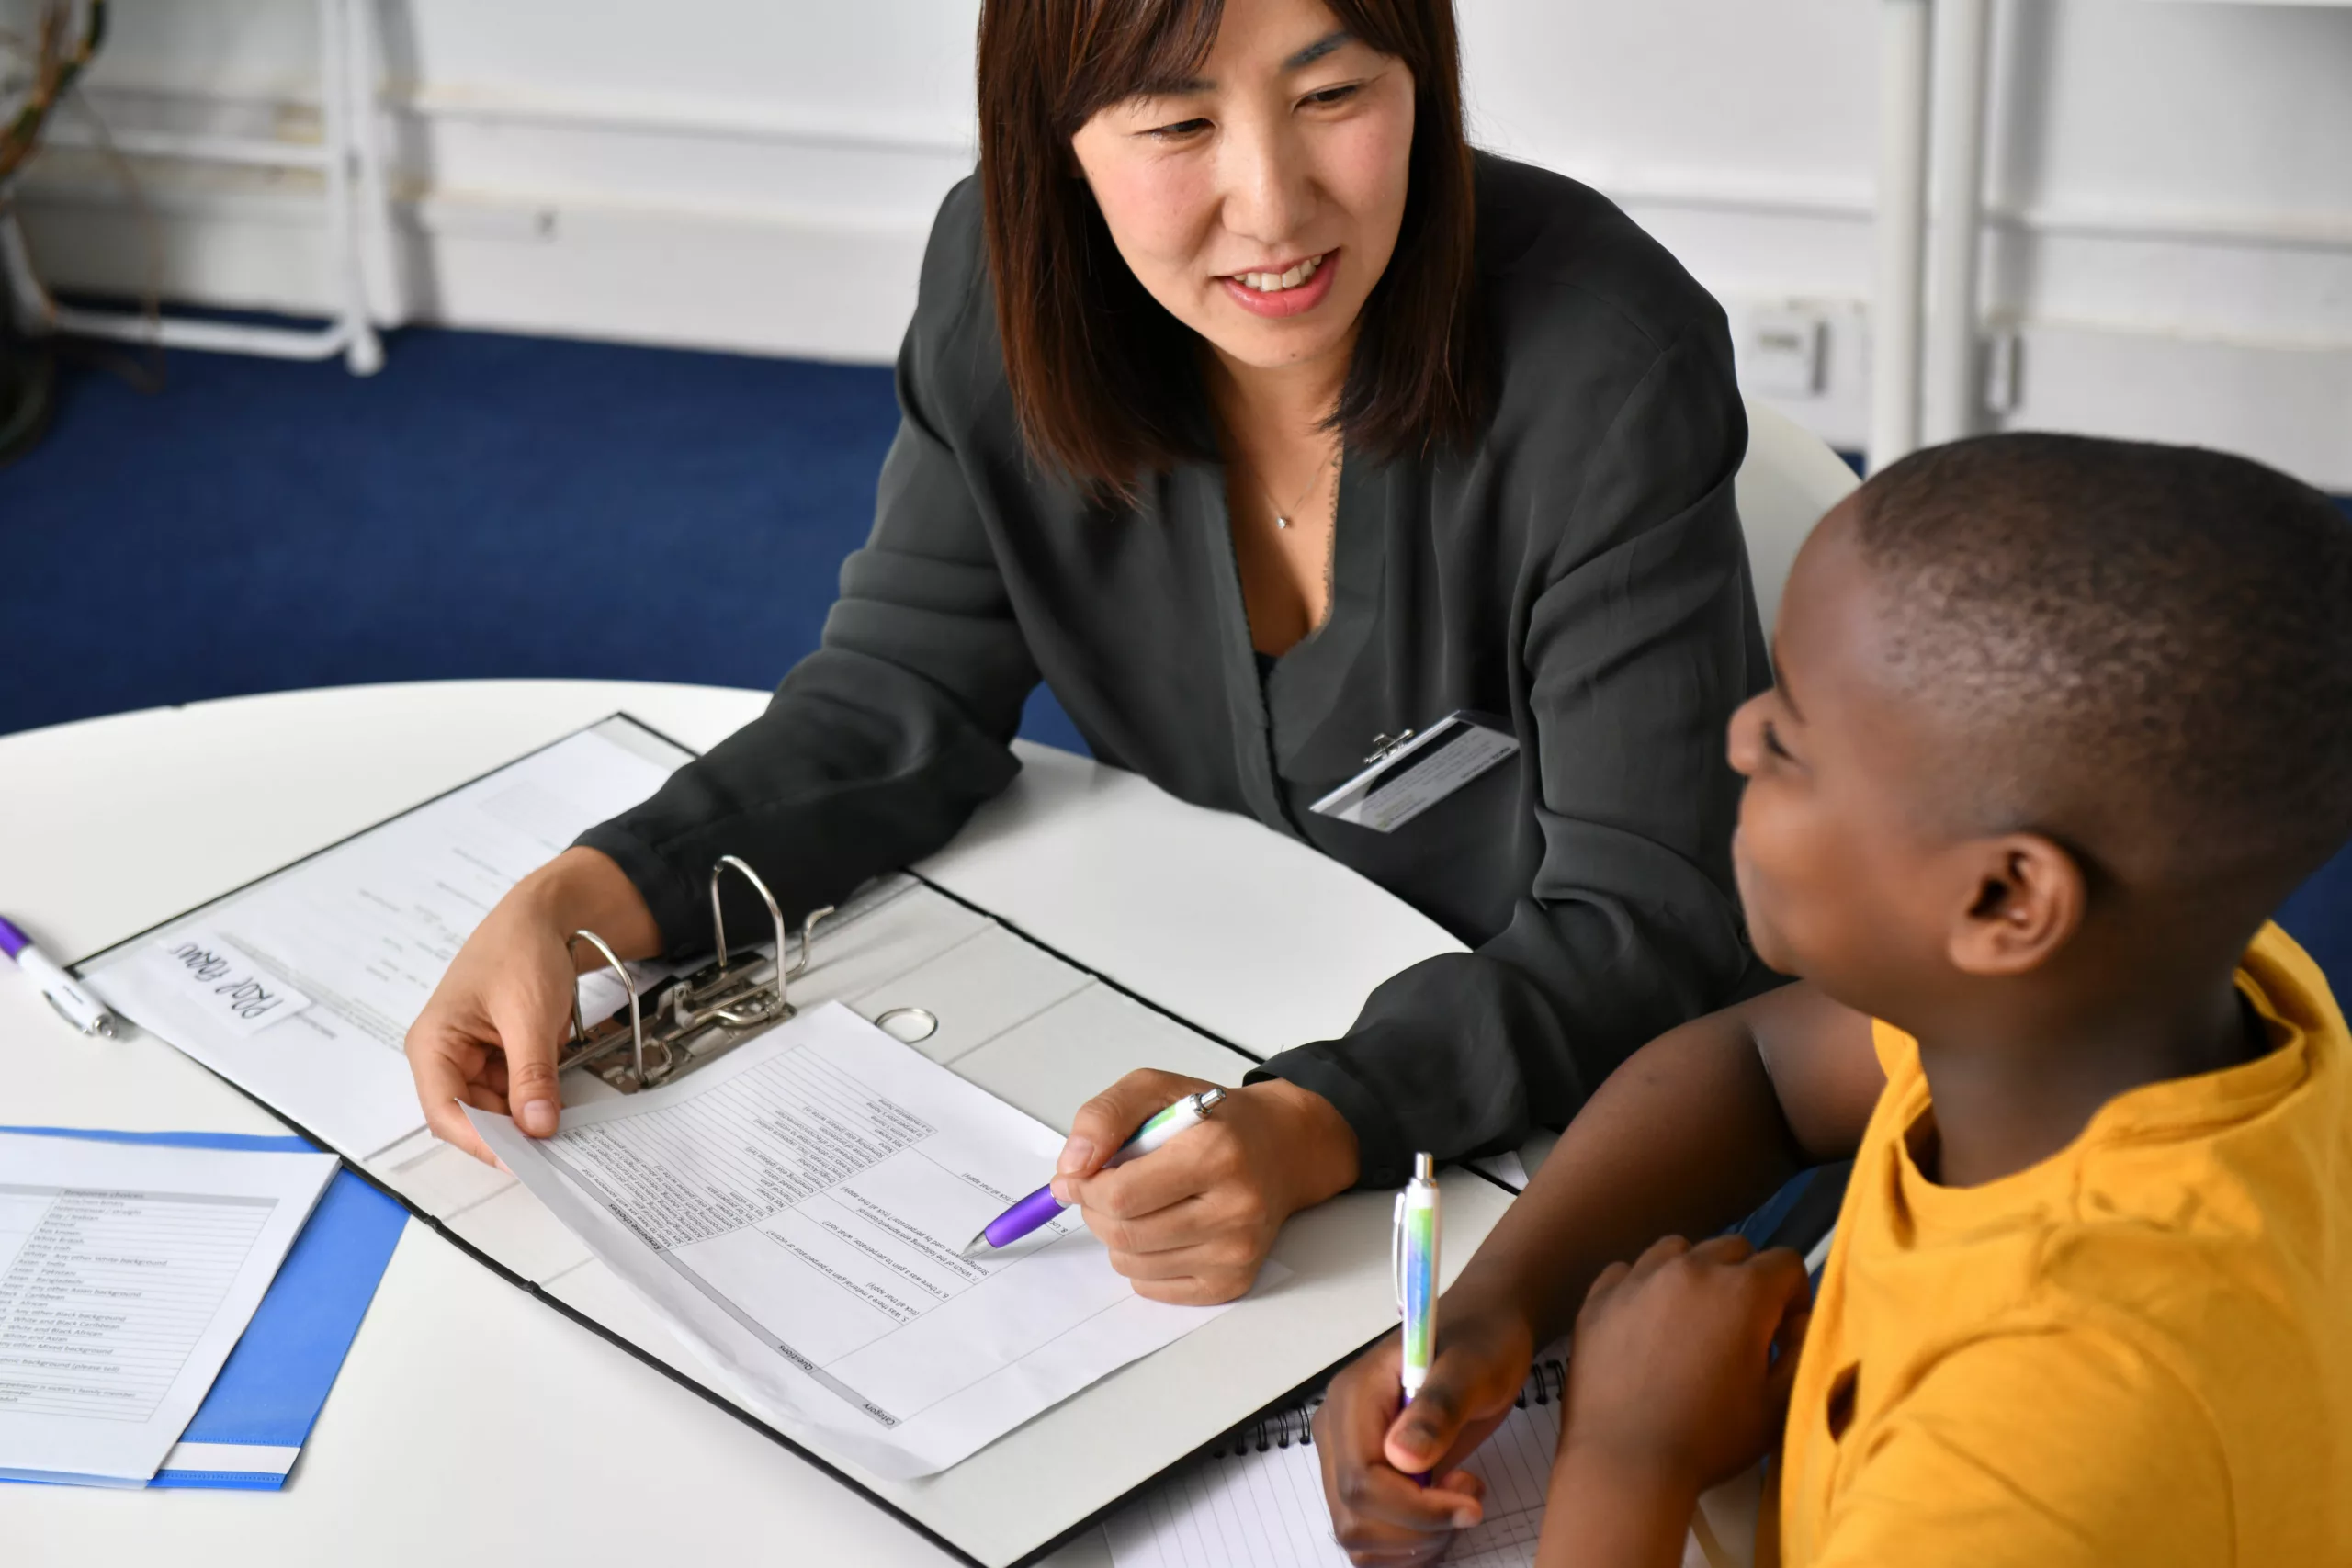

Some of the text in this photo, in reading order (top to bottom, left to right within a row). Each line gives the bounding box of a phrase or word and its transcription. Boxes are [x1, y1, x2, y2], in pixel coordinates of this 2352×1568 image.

[865, 1101, 883, 1113] home
[876, 1099, 895, 1110] home
[810, 1111, 827, 1121] write
[870, 1115, 887, 1126] home
[881, 1111, 918, 1134] perpetrator's
[891, 1108, 922, 1126] residential
[774, 1120, 791, 1132] victim
[775, 1110, 829, 1144] affection/connection
[825, 1120, 848, 1133] (please
[886, 1124, 908, 1138] victim's
[797, 1134, 812, 1145] close
[818, 1126, 849, 1145] protection
[844, 1131, 857, 1140] else
[874, 1128, 904, 1147] Not known
[752, 1117, 846, 1179] Direct threats (incl. exposure online)
[810, 1144, 830, 1156] others
[854, 1137, 886, 1158] Something
[877, 1142, 895, 1154] None
[832, 1147, 865, 1168] Withdrawal
[852, 1147, 876, 1164] Promise
[744, 1145, 817, 1193] Something else (please tell)
[796, 1157, 836, 1183] Drugs/Alcohol
[834, 1158, 855, 1174] Threats
[582, 1168, 594, 1178] else
[961, 1172, 982, 1184] apply)
[763, 1168, 807, 1198] Increased status
[801, 1171, 826, 1189] Presents
[978, 1182, 994, 1191] that
[592, 1178, 617, 1198] someone
[760, 1179, 796, 1203] Financial gain
[838, 1186, 860, 1198] apply)
[615, 1197, 629, 1208] with
[653, 1164, 735, 1229] Something else (please write in)
[706, 1186, 740, 1208] perpetrator
[729, 1191, 747, 1203] victim
[755, 1187, 786, 1208] Not known
[856, 1196, 872, 1206] that
[998, 1193, 1014, 1201] (tick
[627, 1207, 639, 1215] sex
[715, 1203, 745, 1225] Not known
[744, 1213, 755, 1222] Yes
[753, 1209, 765, 1217] Yes
[875, 1208, 892, 1218] (tick
[608, 1203, 662, 1250] Response choices
[629, 1200, 684, 1245] Sex for financial gain
[637, 1216, 650, 1228] have
[820, 1220, 840, 1230] sort?
[855, 1207, 912, 1240] entrapment/control
[887, 1216, 927, 1236] perpetrator?
[656, 1233, 673, 1247] Made
[765, 1229, 788, 1244] victim?
[835, 1228, 854, 1239] what
[852, 1237, 888, 1259] perpetrator,
[910, 1238, 938, 1257] following
[929, 1239, 947, 1249] used
[793, 1247, 829, 1269] perpetrator
[935, 1254, 948, 1262] the
[891, 1262, 908, 1271] gain
[952, 1264, 973, 1278] Which
[831, 1271, 848, 1281] gain
[909, 1272, 922, 1281] was
[842, 1280, 869, 1296] material
[865, 1281, 887, 1294] apply)
[920, 1280, 938, 1292] there
[872, 1297, 889, 1310] there
[882, 1293, 899, 1303] that
[887, 1307, 902, 1318] Was
[902, 1305, 922, 1316] (tick
[778, 1344, 814, 1371] Questions
[862, 1401, 897, 1427] Category
